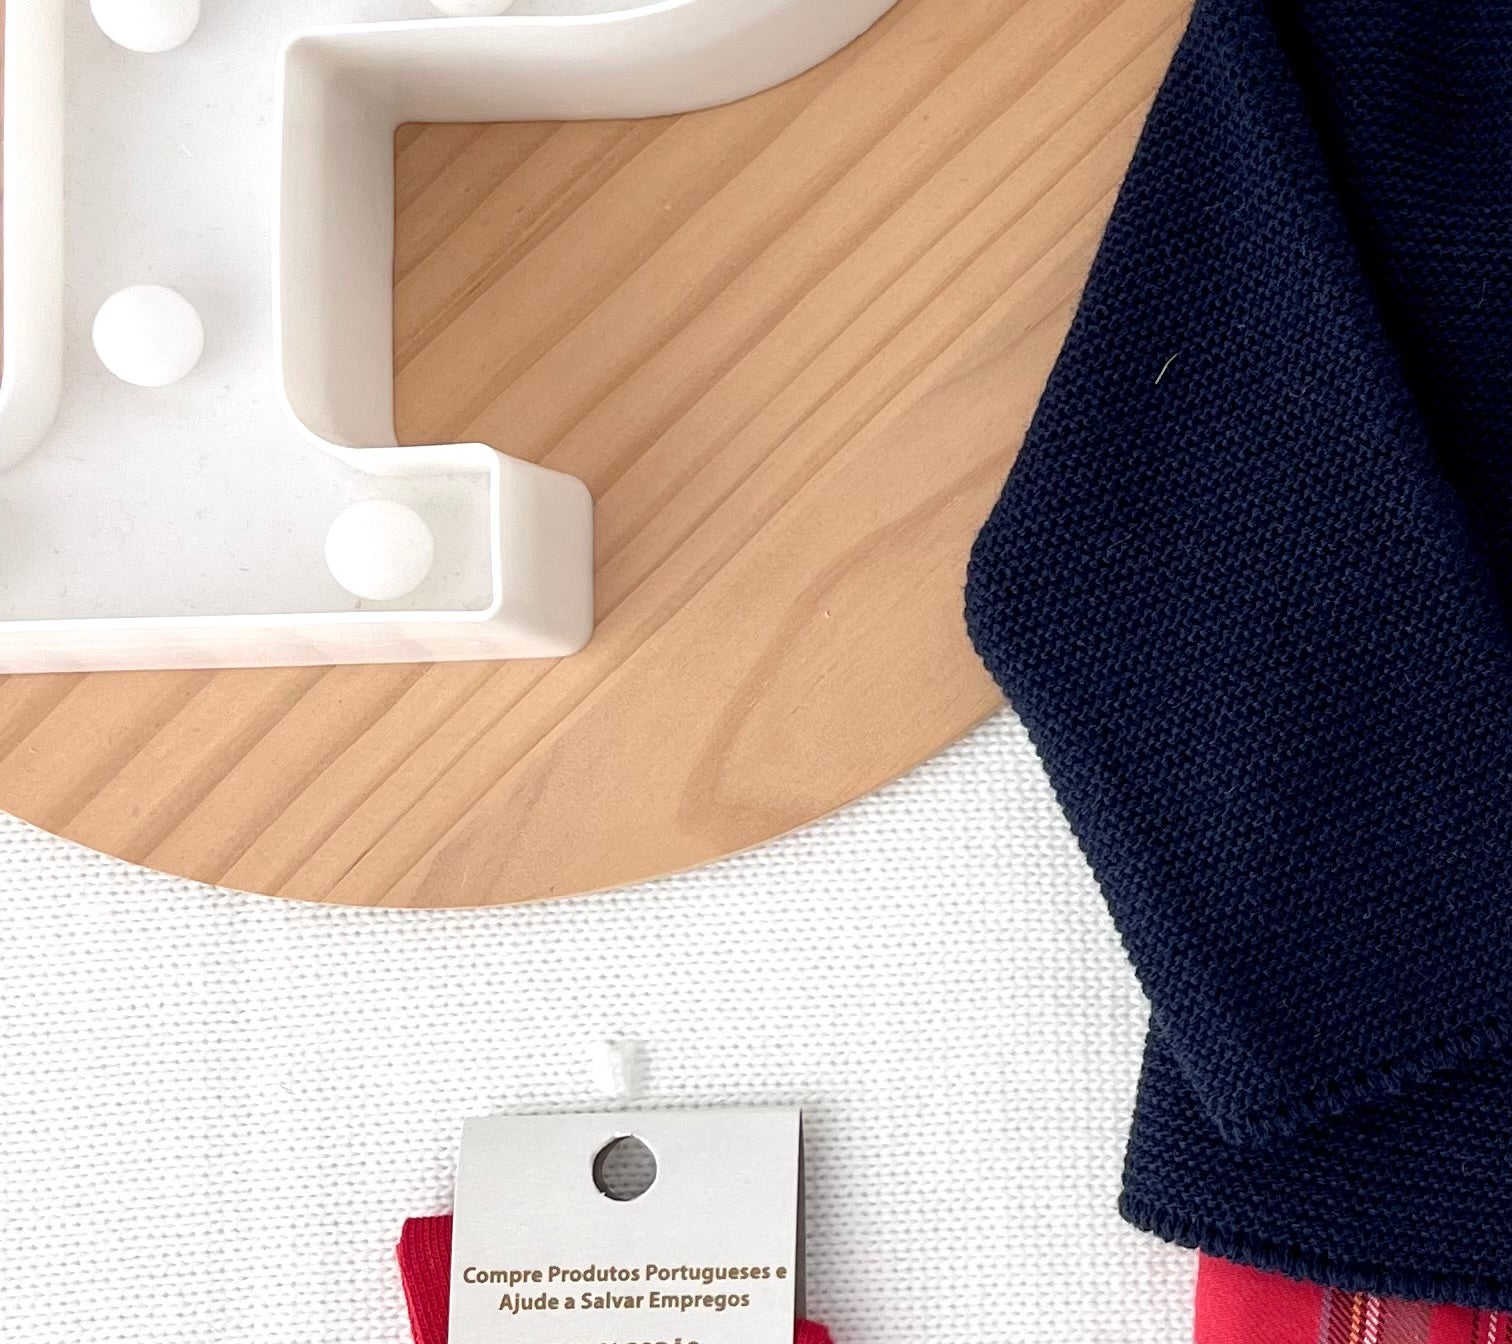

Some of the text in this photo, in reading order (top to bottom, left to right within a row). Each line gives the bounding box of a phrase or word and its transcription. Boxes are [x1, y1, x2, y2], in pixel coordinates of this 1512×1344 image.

[463, 1264, 788, 1287] Compre Produtos Portugueses e
[498, 1290, 750, 1315] Ajude a Salvar Empregos
